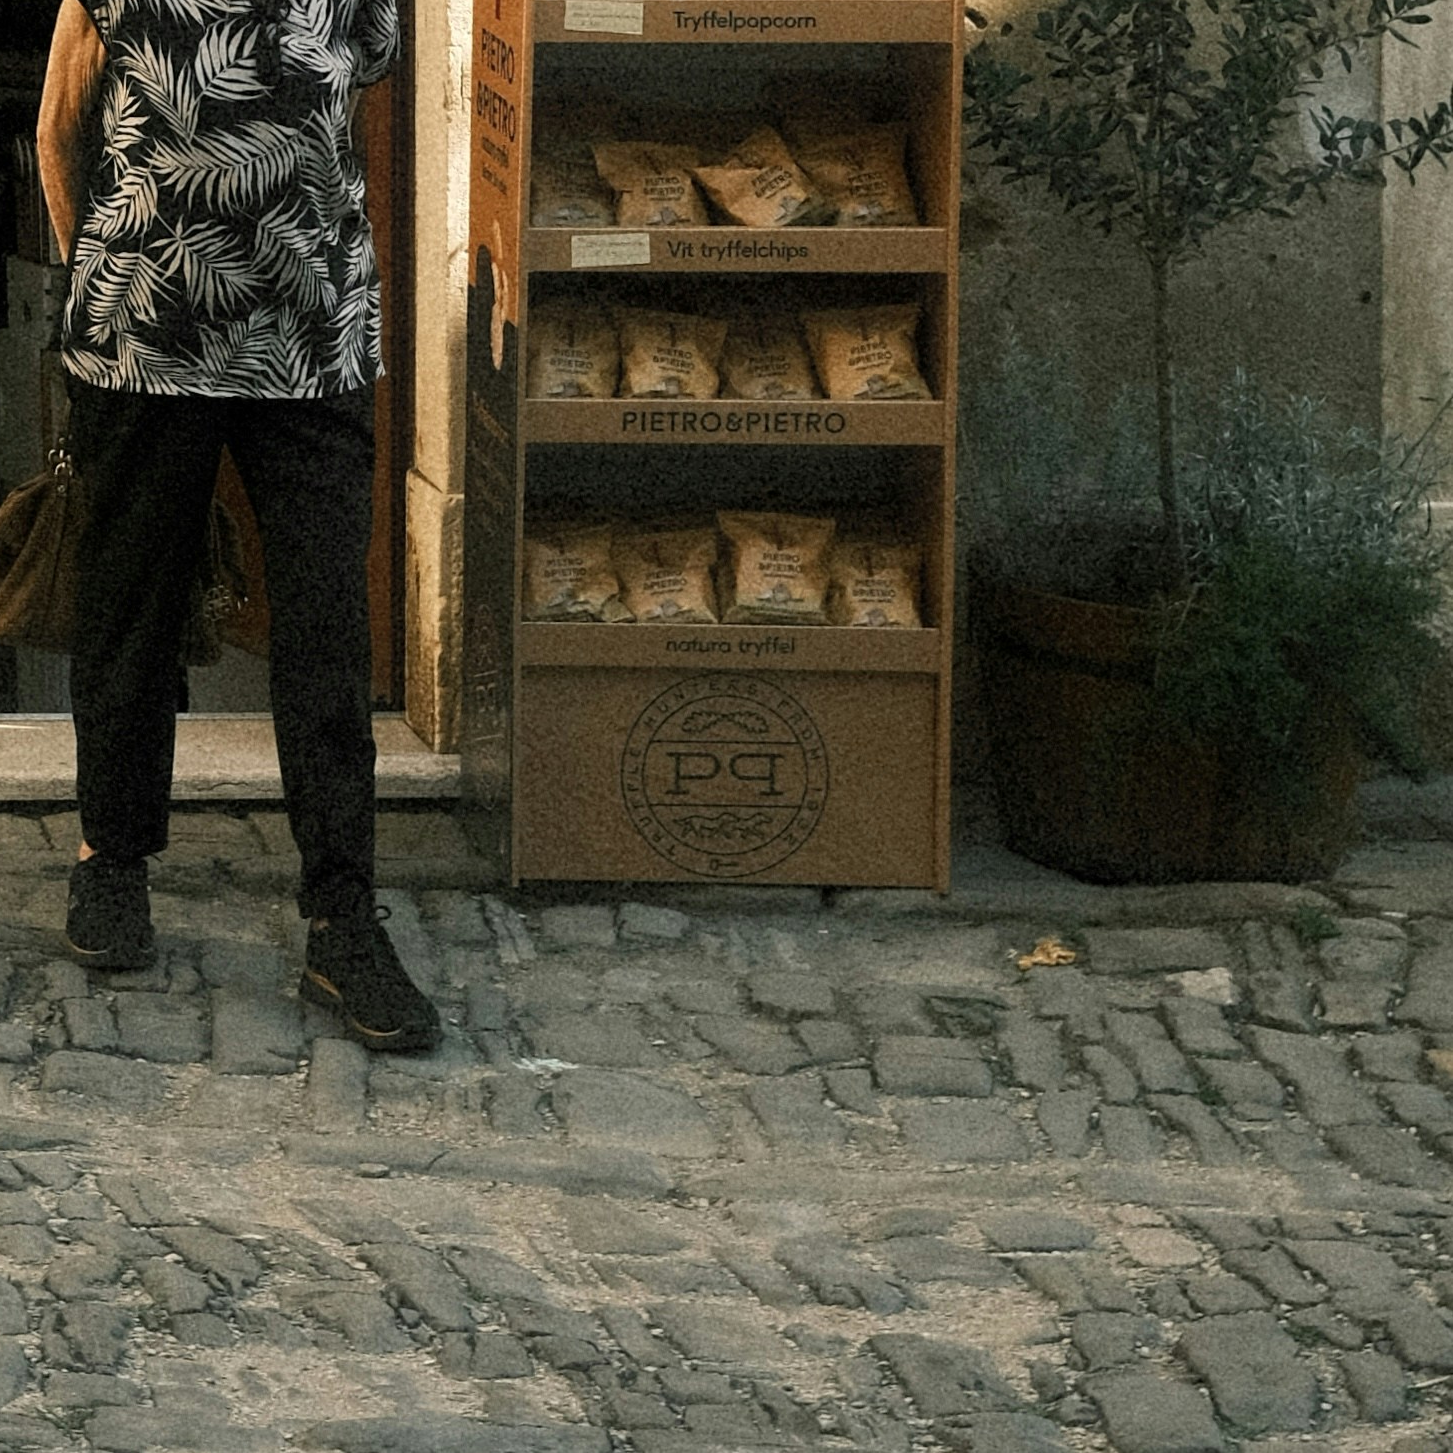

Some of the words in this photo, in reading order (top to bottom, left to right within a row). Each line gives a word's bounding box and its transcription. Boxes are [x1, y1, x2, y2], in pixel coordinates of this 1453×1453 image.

[673, 10, 817, 35] Tryffelpopcorn
[481, 28, 515, 85] PIETRO
[667, 240, 695, 258] Vit
[700, 239, 809, 265] tryffelchips
[622, 412, 847, 434] PIETRO&PIETRO
[666, 638, 731, 654] natura
[739, 636, 796, 657] tryffel
